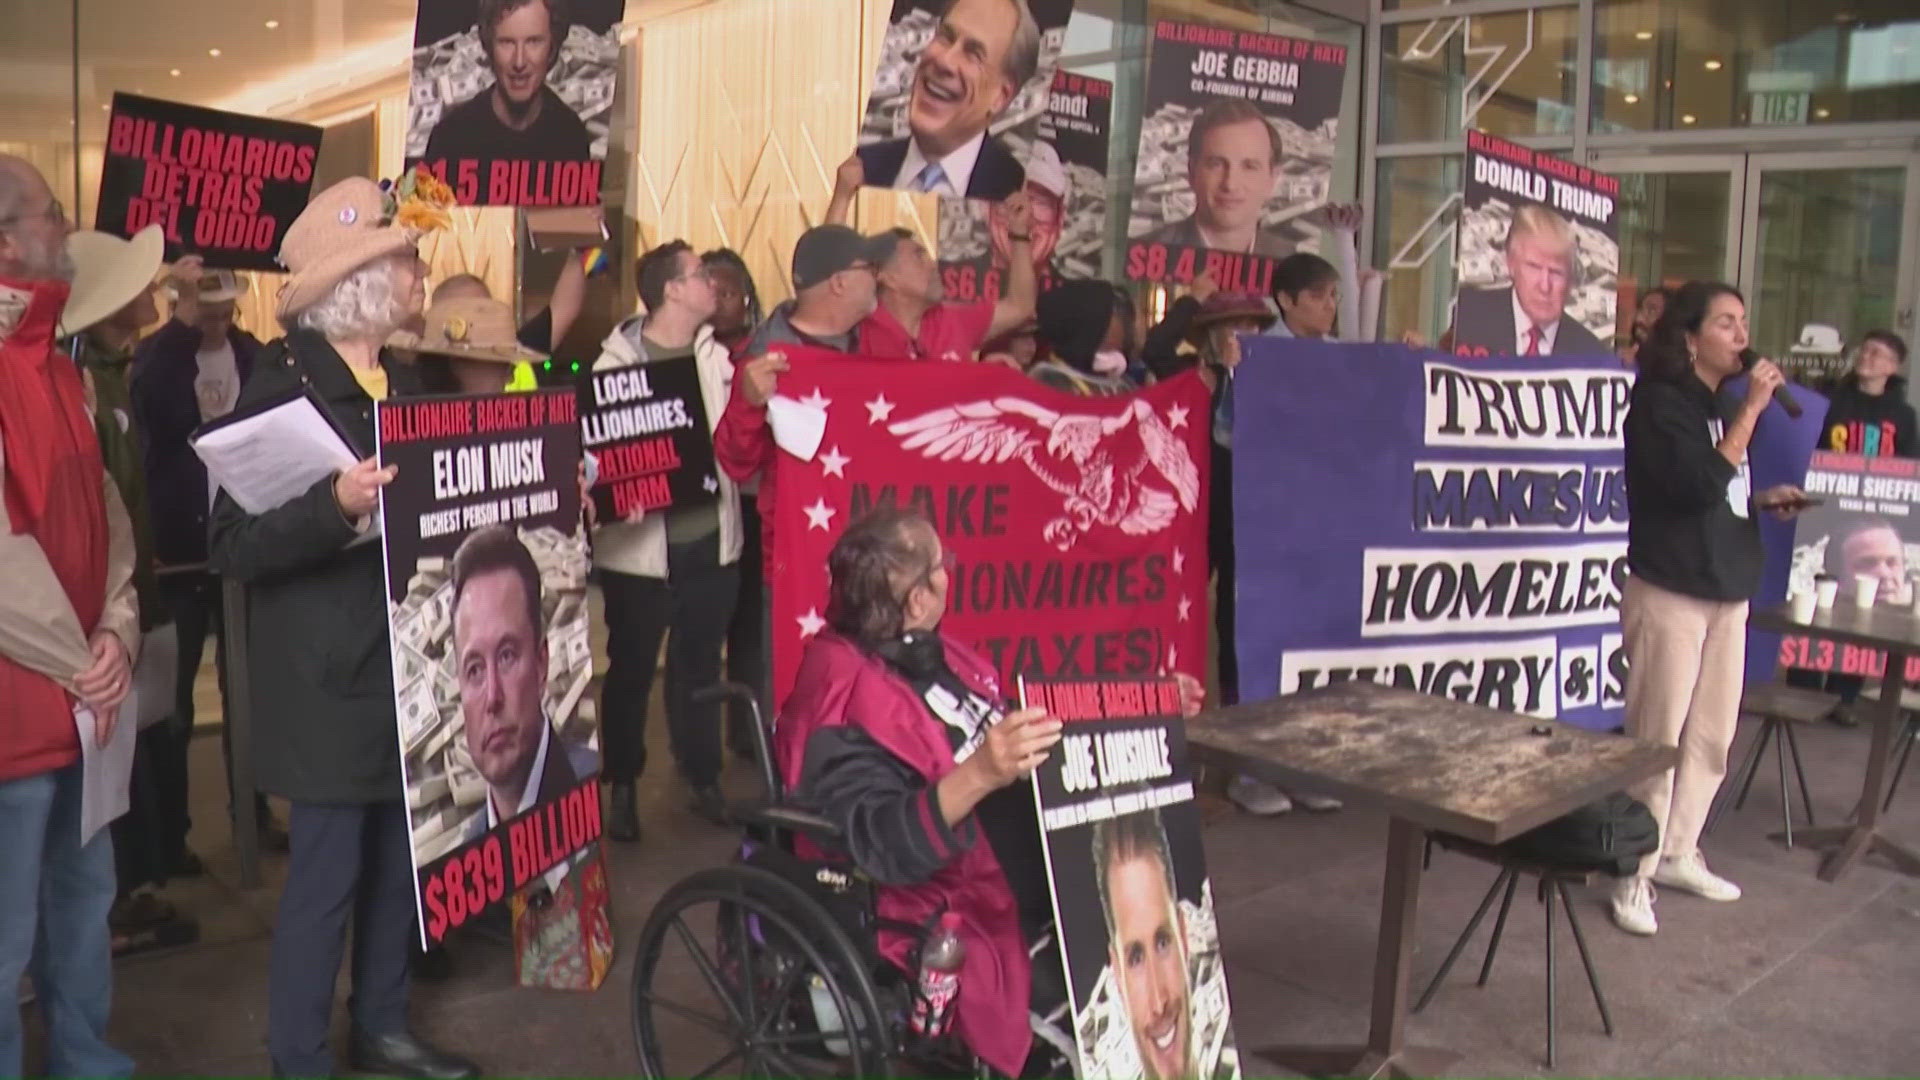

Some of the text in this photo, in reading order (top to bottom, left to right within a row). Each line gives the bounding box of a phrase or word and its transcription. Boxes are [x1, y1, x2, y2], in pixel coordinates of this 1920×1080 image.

[1157, 21, 1347, 65] BILLIONAIRE BACKER OF HATE
[1191, 50, 1299, 89] JOE GEBBIA
[1049, 91, 1089, 119] andt
[110, 115, 315, 182] BILLONARIOS
[142, 160, 264, 214] DETRAS
[489, 160, 601, 206] BILLION
[1474, 154, 1548, 203] DONALD
[1551, 179, 1614, 224] TRUMP
[194, 209, 277, 250] OIDIO
[1126, 245, 1278, 296] $8.4 BILLI
[592, 368, 654, 406] LOCAL
[380, 392, 577, 443] BILLIONAIRE BACKER OF HATE
[581, 398, 694, 446] LLIONAIRES,
[433, 437, 546, 501] ELON MUSK
[1804, 469, 1920, 503] BRYAN SHEFFI
[419, 489, 560, 540] RICHEST PERSON IN THE WORLD
[611, 474, 673, 516] HARM
[1414, 468, 1583, 530] MAKES
[954, 554, 1168, 617] IONAIRES
[1365, 556, 1632, 625] HOMELES
[1780, 634, 1835, 673] $1.3
[1564, 656, 1595, 703] &
[1061, 726, 1173, 794] JOE LONSDALE
[425, 777, 601, 943] $839 BILLION
